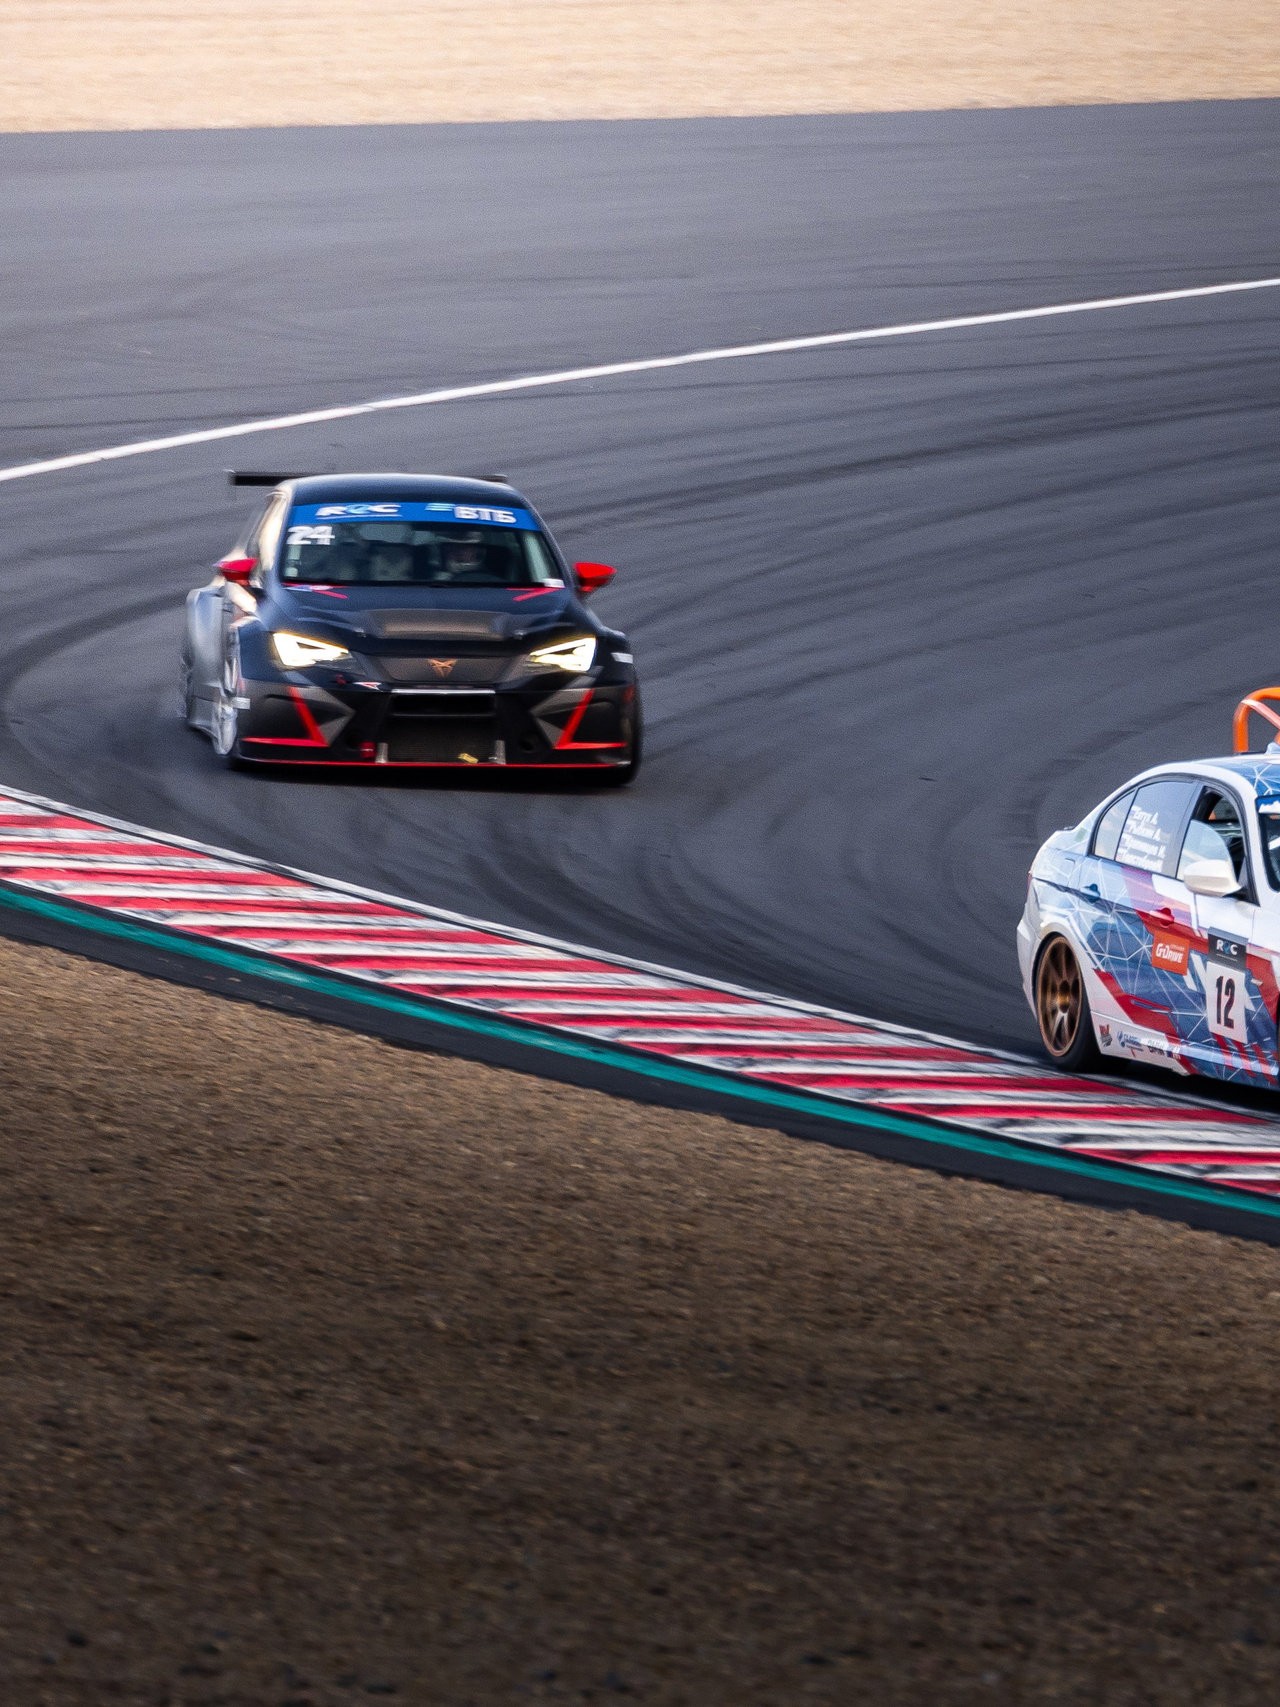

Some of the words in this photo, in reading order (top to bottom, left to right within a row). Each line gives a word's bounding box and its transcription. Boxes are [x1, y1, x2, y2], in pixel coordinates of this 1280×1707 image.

[454, 506, 517, 524] ВТБ
[286, 525, 335, 546] 24
[1216, 976, 1236, 1029] 12
